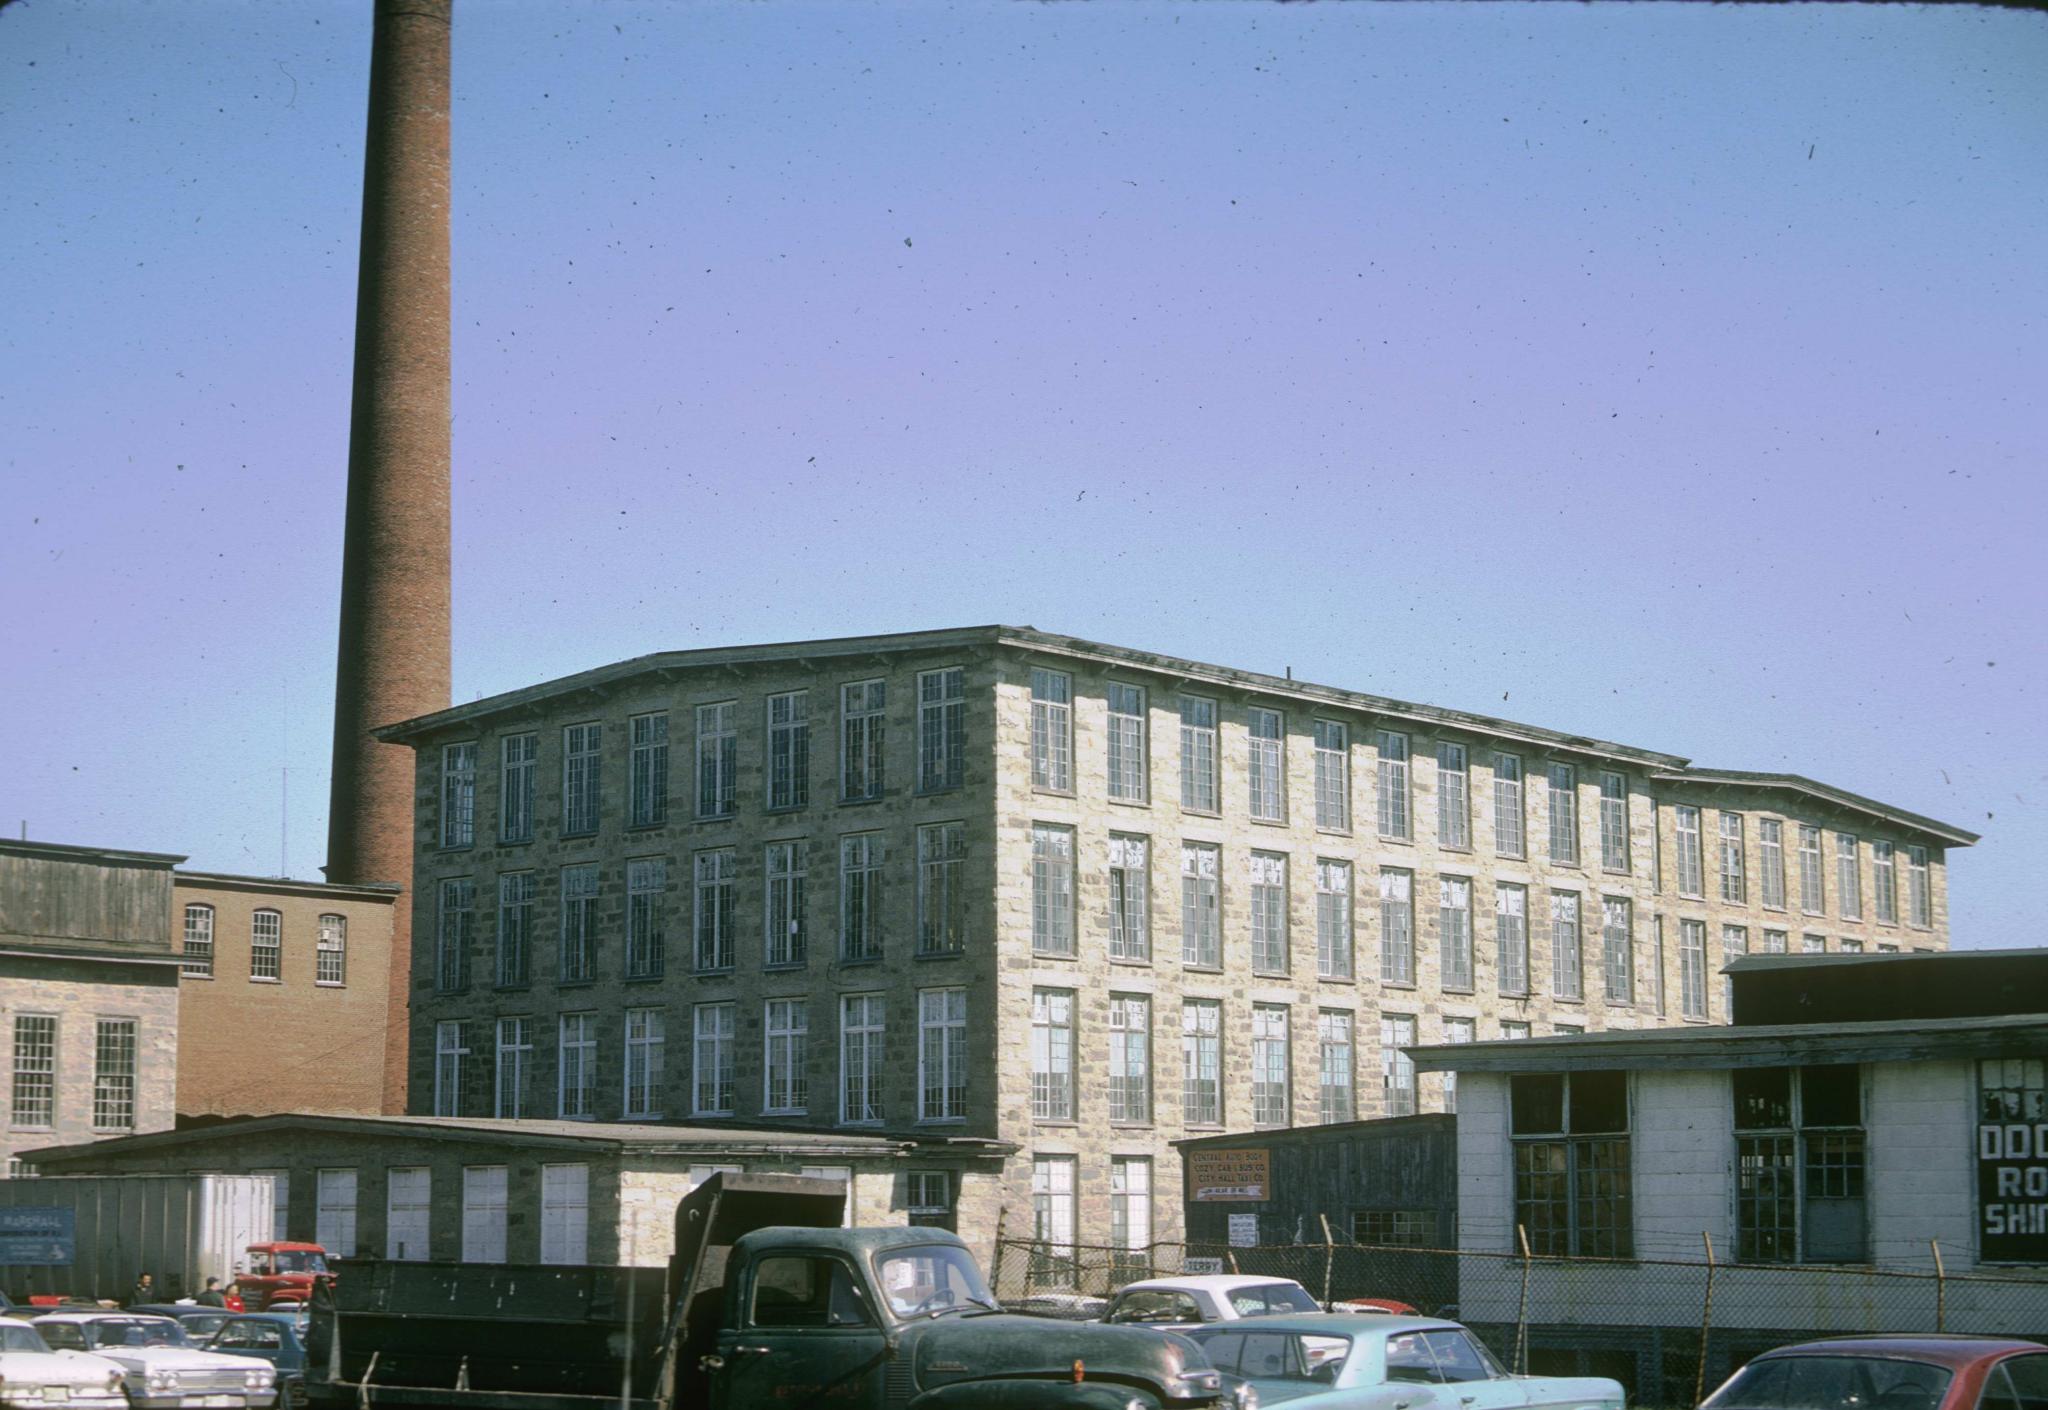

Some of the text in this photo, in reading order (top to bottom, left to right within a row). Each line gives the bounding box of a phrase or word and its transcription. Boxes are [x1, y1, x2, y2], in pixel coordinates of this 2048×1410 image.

[1194, 1164, 1213, 1173] COZY
[1218, 1164, 1231, 1172] CAB
[1199, 1174, 1213, 1183] CITY
[1218, 1174, 1234, 1183] HALL
